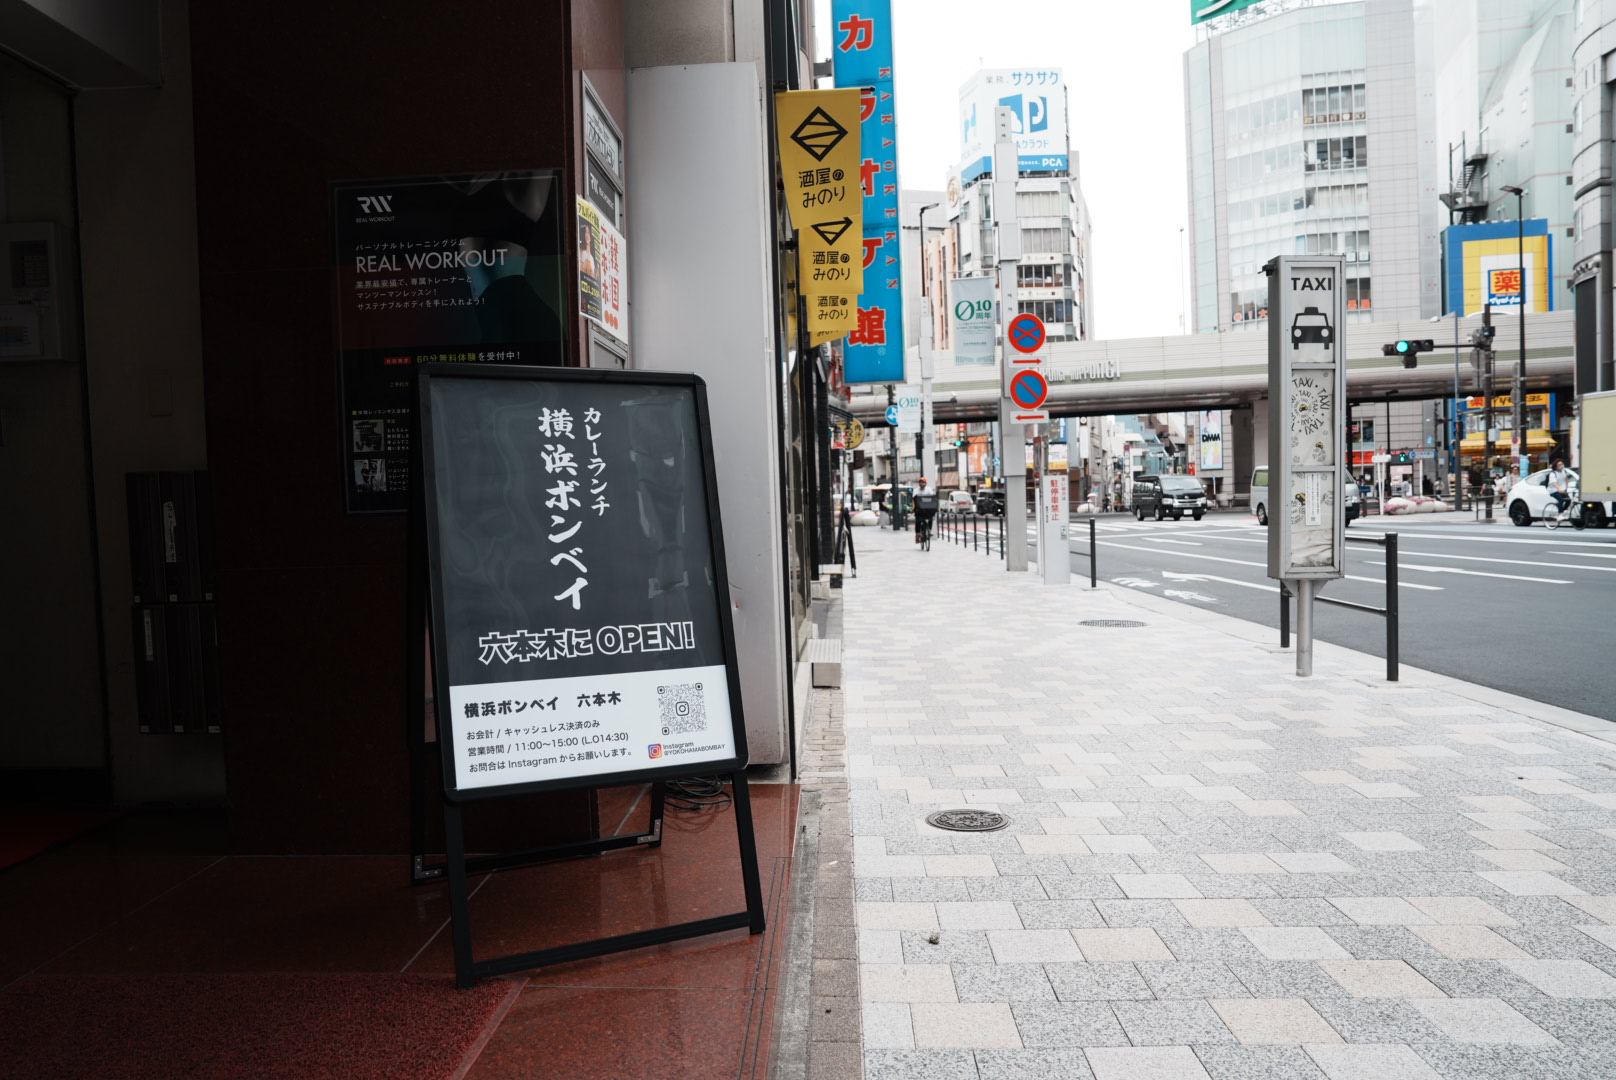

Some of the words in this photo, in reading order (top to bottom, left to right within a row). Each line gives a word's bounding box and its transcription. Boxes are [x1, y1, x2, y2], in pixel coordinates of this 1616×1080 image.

[1042, 158, 1063, 167] PCA
[798, 167, 844, 188] 酒屋の
[803, 186, 845, 208] みのり
[369, 215, 395, 223] WORKOUT
[355, 238, 465, 251] パーソナルトレーニングジム
[356, 254, 401, 273] REAL
[404, 248, 508, 271] WORKOUT
[812, 250, 850, 265] 酒屋の
[355, 275, 473, 289] 業界最安値で、専属トレーナーと
[812, 267, 851, 281] みのり
[1494, 270, 1521, 292] 薬
[1291, 277, 1332, 291] TAXI
[975, 299, 992, 312] 10
[817, 309, 848, 320] みのり
[975, 312, 992, 320] 周年
[1292, 377, 1314, 389] TAXI
[1299, 390, 1312, 398] TAXI
[1317, 388, 1330, 410] TAXI
[1304, 418, 1324, 436] TAXI
[1202, 433, 1221, 443] DMM
[584, 407, 610, 517] カレーランチ
[1050, 479, 1060, 521] 駐停車禁止
[538, 407, 589, 610] 横浜ボンベイ
[478, 627, 593, 666] 六本木に
[596, 621, 695, 656] OPEN!
[464, 696, 560, 719] 横浜ボンベイ
[576, 690, 622, 708] 六本木
[466, 729, 494, 740] お会計
[504, 719, 600, 737] キャッシュレス決済のみ
[467, 744, 505, 757] 営業時間
[581, 732, 630, 748] (L.O14:30)
[662, 740, 695, 750] Instagram
[469, 760, 506, 773] お問合は
[508, 755, 557, 770] Instagram
[559, 747, 633, 764] からお願いします。
